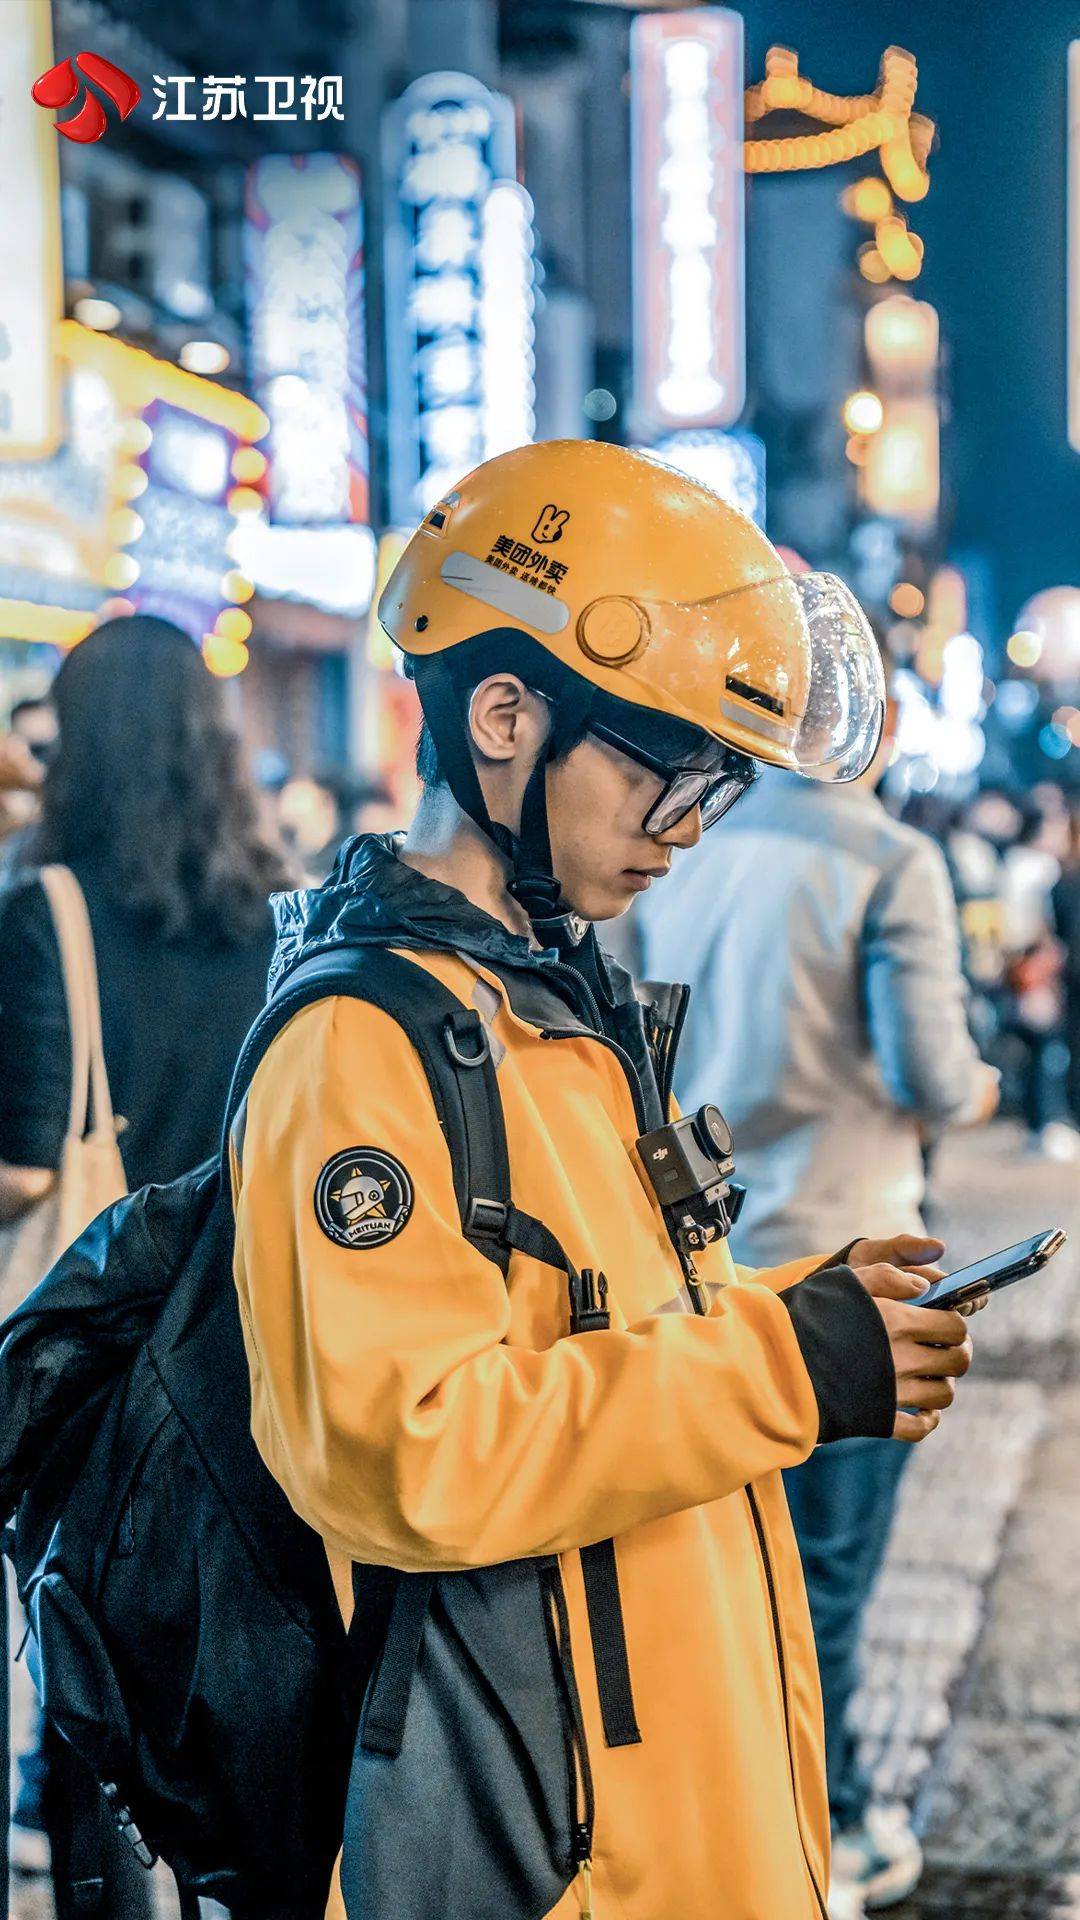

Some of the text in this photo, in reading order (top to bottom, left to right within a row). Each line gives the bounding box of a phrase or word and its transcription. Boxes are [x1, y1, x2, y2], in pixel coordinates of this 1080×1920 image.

[491, 534, 569, 585] 美团外卖
[348, 1221, 391, 1239] MEITUAN
